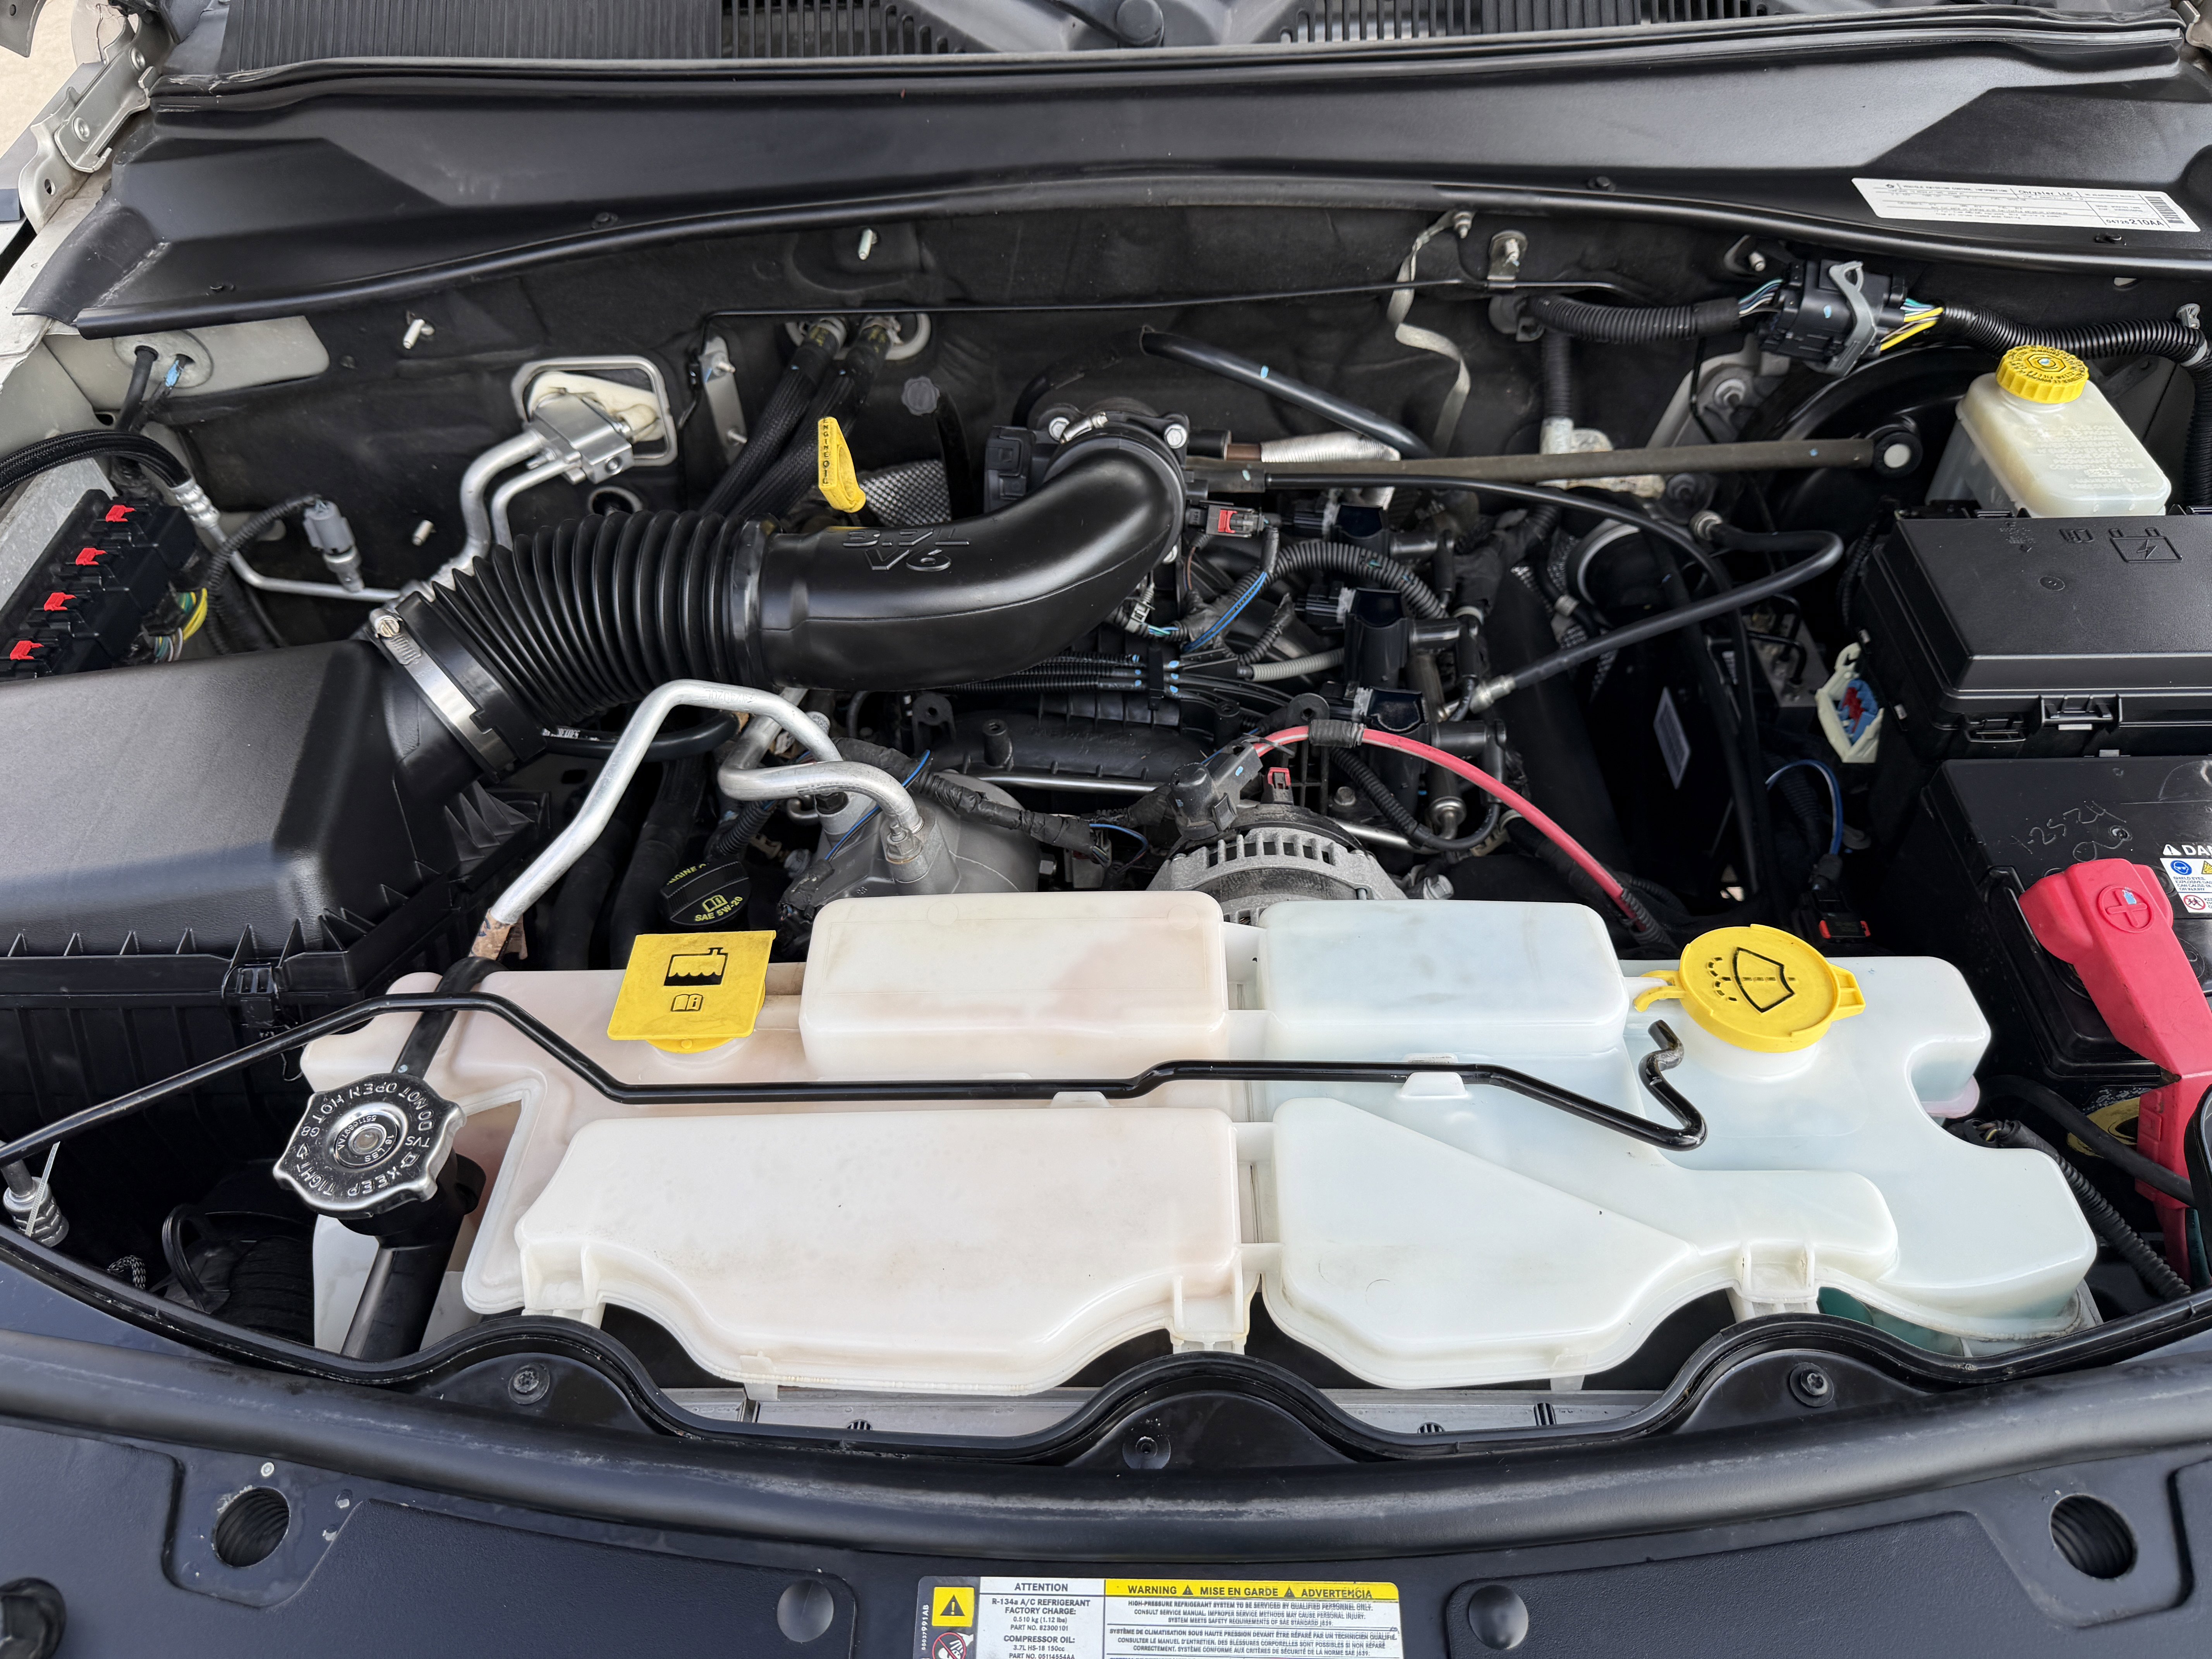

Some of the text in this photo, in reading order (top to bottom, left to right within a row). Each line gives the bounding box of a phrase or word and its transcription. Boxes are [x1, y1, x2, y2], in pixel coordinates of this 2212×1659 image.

[843, 529, 969, 546] 3.7L
[865, 549, 952, 572] V6
[695, 896, 743, 922] SAE 5W-20
[312, 1082, 434, 1131] DO NOT OPEN HOT
[405, 1135, 430, 1148] TVS
[364, 1147, 385, 1162] LBS
[296, 1162, 403, 1197] KEEP TIGHT
[1014, 1583, 1068, 1592] ATTENTION
[1128, 1585, 1372, 1599] WARNING MISE EN GARDE ADVERTENCIA
[1020, 1598, 1036, 1607] A/C
[1003, 1635, 1058, 1643] COMPRESSOR
